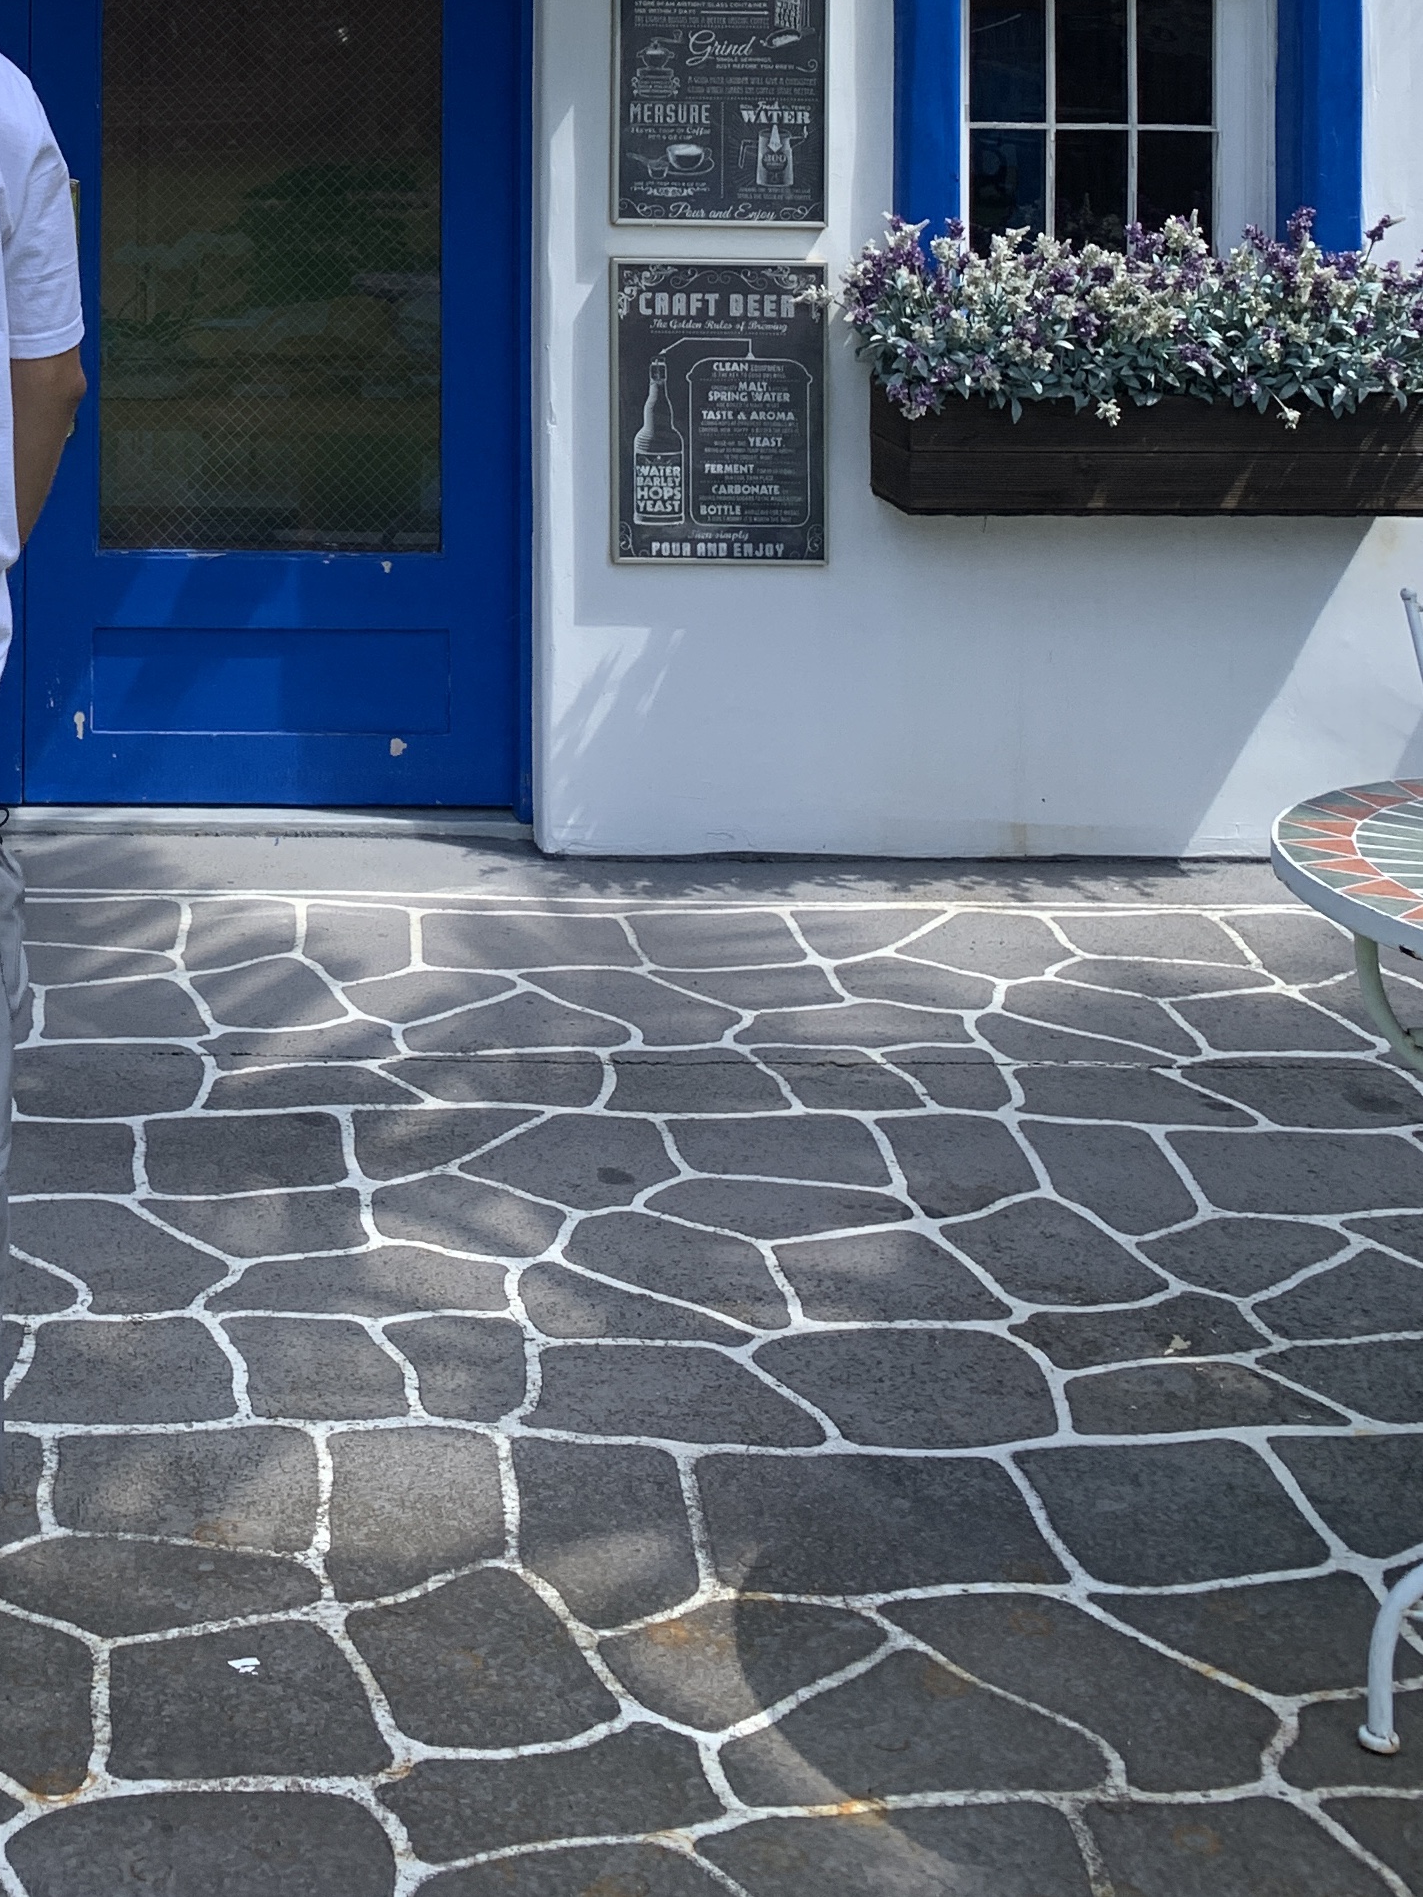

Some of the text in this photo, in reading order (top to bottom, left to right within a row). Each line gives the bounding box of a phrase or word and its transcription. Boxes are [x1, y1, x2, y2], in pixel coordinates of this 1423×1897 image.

[686, 30, 756, 66] Grind
[629, 103, 711, 124] MEASURE
[740, 110, 811, 124] WATER
[668, 201, 776, 221] Pour and Enjoy
[639, 292, 795, 318] CRAFT BEER
[649, 319, 788, 332] The Golden Rules of Brewing
[713, 362, 748, 371] CLEAN
[738, 382, 768, 391] MALT
[708, 391, 790, 402] SPRING WATER
[702, 410, 733, 420] TASTE
[737, 411, 746, 420] &
[636, 465, 681, 476] WATER
[704, 464, 754, 474] FERMENT
[636, 477, 681, 487] BARLEY
[636, 487, 681, 500] HOPS
[711, 484, 780, 494] CARBONATE
[637, 501, 680, 512] YEAST
[700, 505, 741, 515] BOTTLE
[714, 531, 749, 541] simply
[651, 542, 784, 557] POUR AND ENJOY
